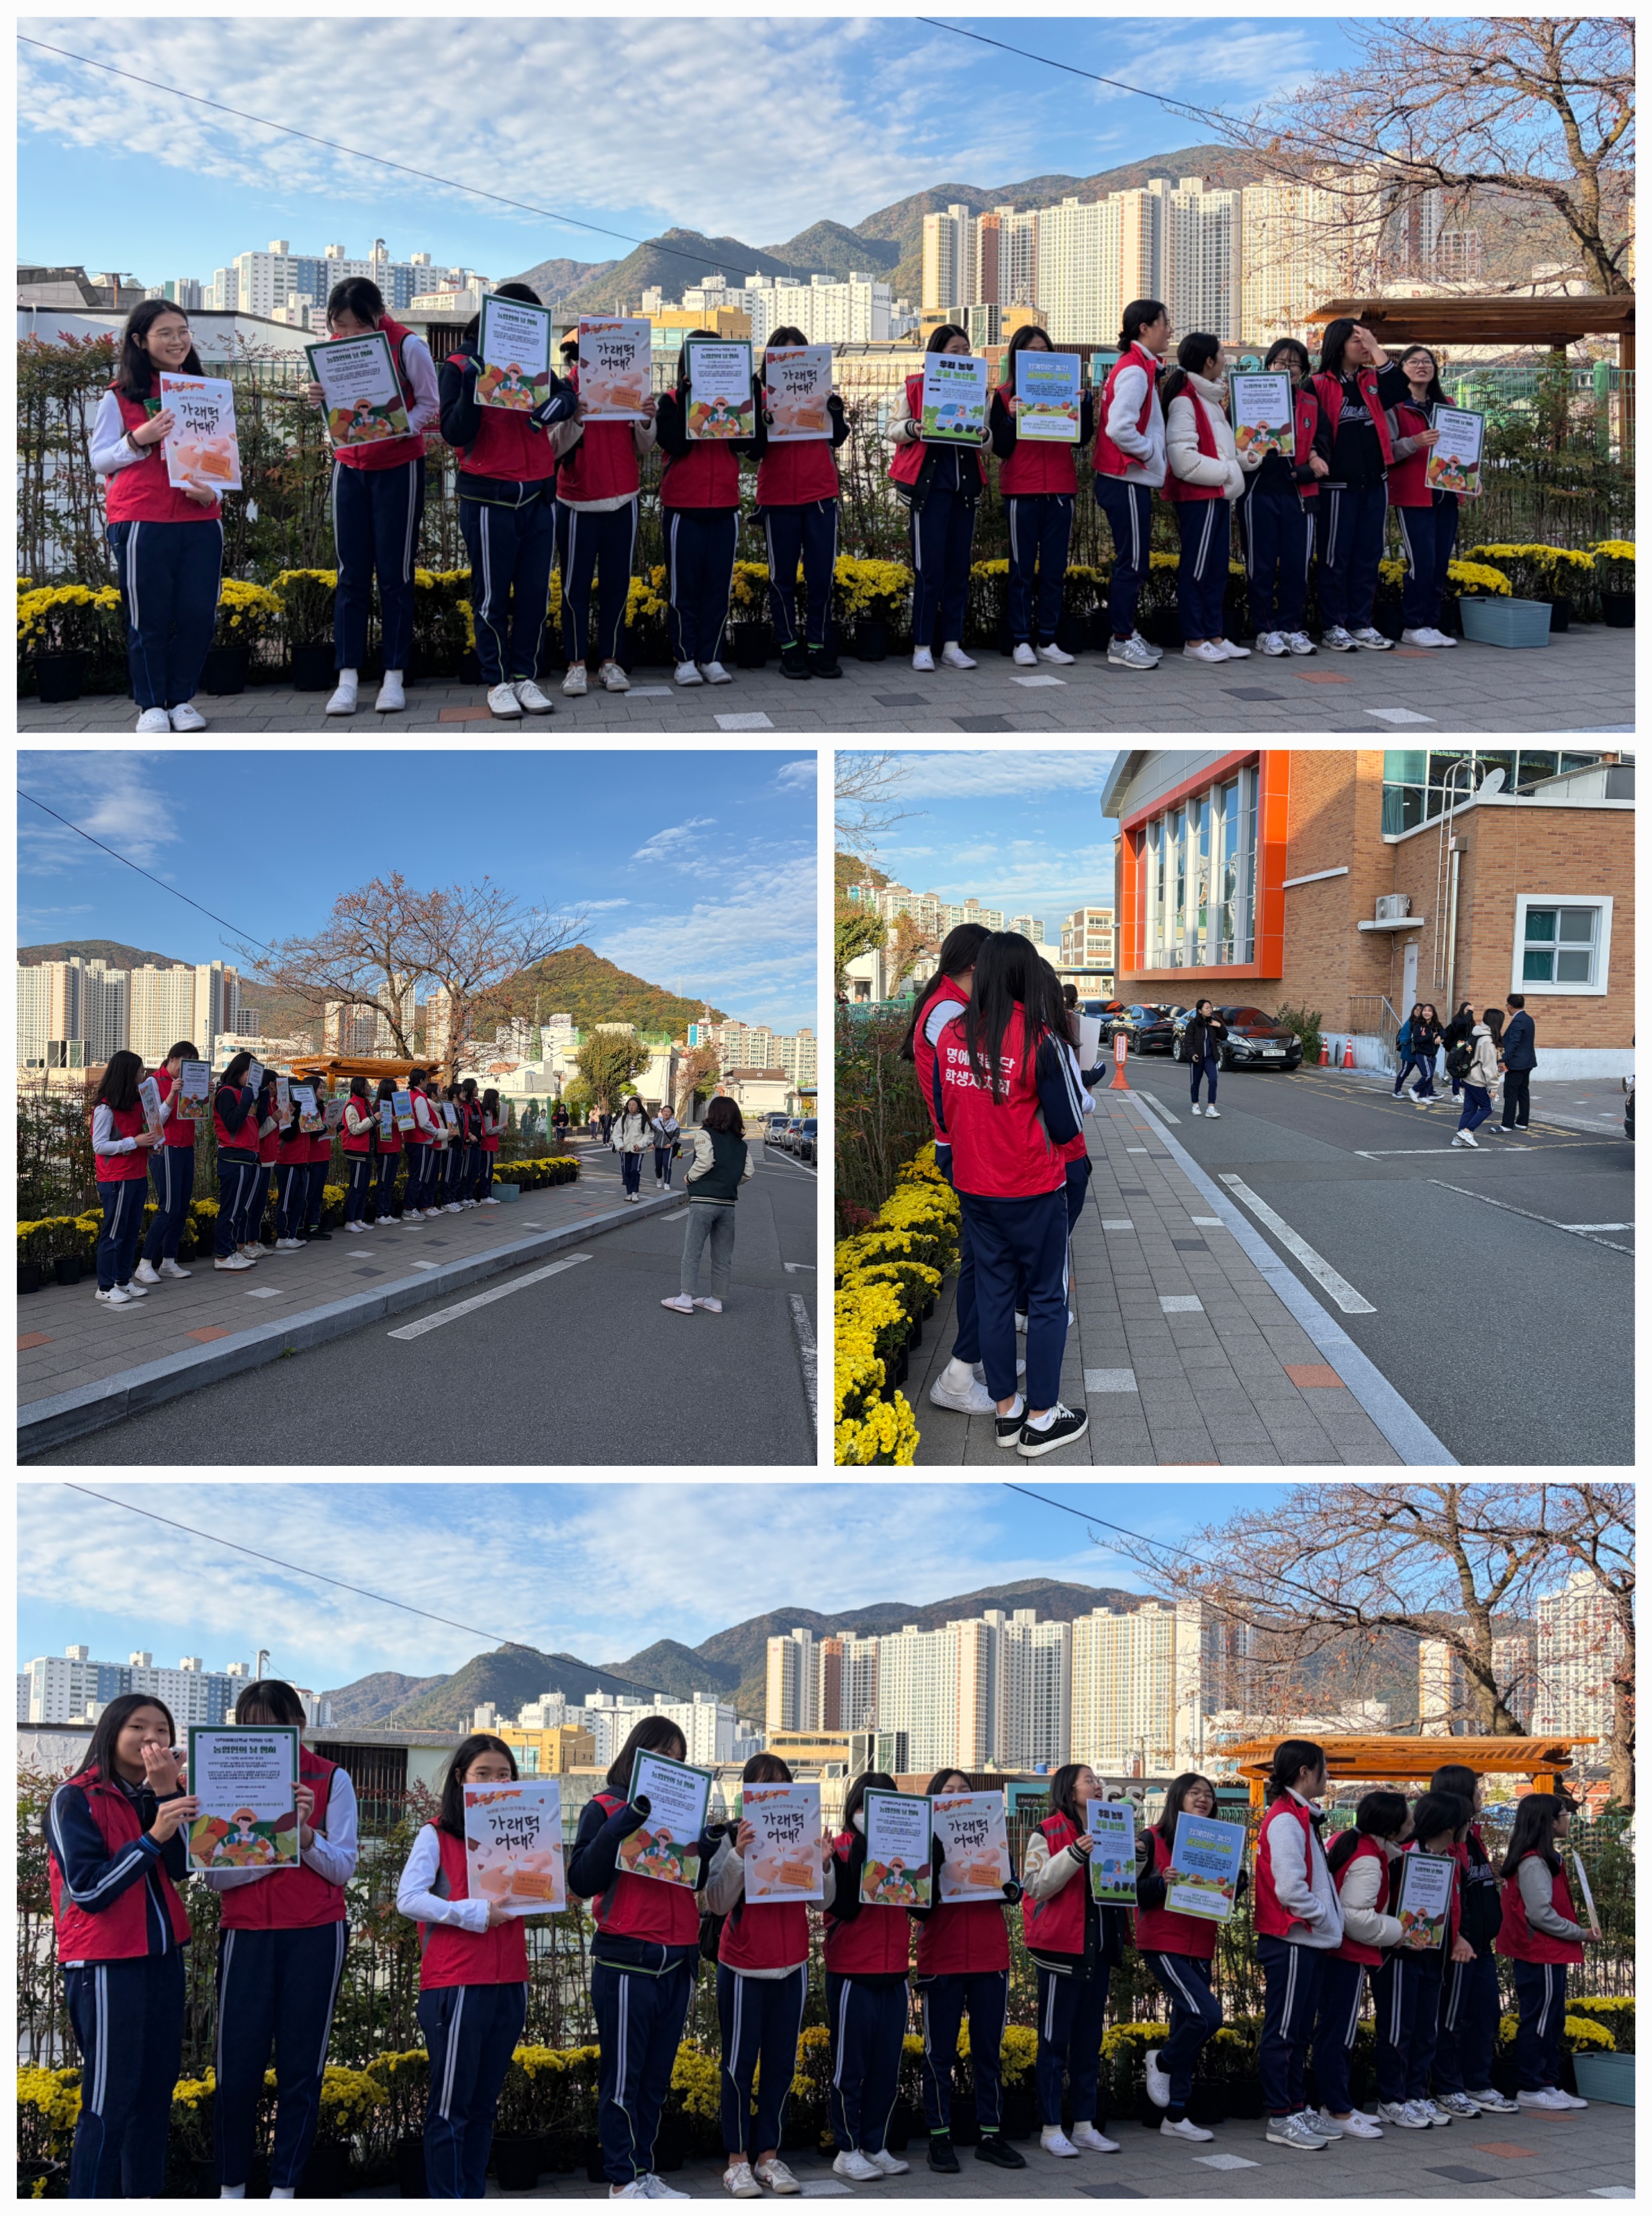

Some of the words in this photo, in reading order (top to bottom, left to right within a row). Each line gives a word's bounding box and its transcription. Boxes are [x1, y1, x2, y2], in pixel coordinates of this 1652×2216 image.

[596, 342, 635, 359] 가래떡
[600, 357, 631, 371] 어때?
[939, 360, 956, 369] 우리
[958, 362, 974, 371] 농부
[782, 369, 818, 383] 가래떡
[786, 382, 814, 395] 어때?
[181, 402, 220, 422] 가래떡
[185, 418, 216, 435] 어때?
[762, 1812, 805, 1829] 가래떡
[1098, 1808, 1110, 1818] 우리
[1111, 1810, 1123, 1820] 농부
[489, 1815, 540, 1833] 가래떡
[948, 1818, 989, 1834] 가래떡
[496, 1832, 535, 1851] 어때?
[768, 1828, 800, 1844] 어때?
[954, 1833, 986, 1848] 어때?
